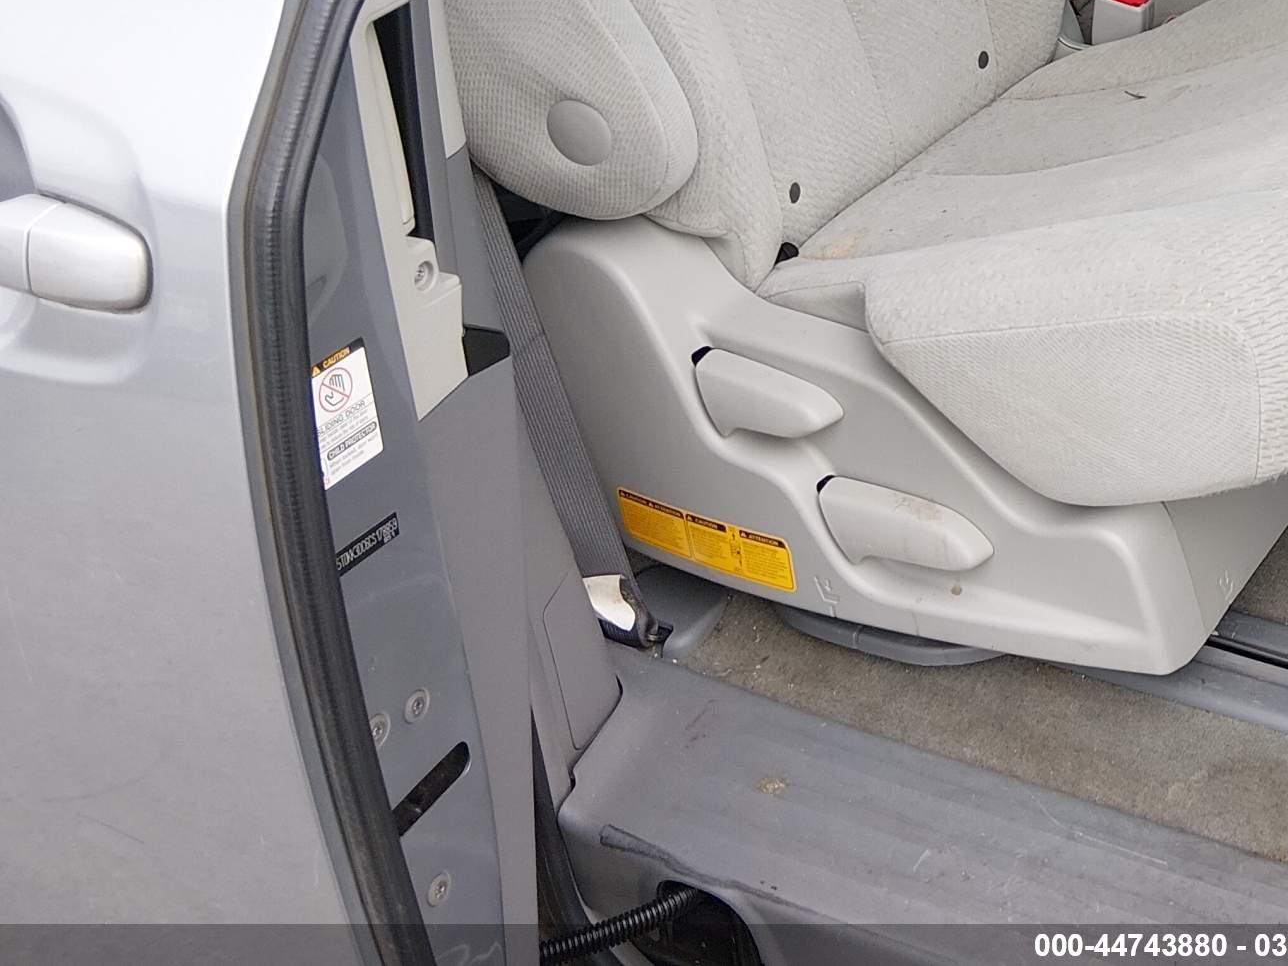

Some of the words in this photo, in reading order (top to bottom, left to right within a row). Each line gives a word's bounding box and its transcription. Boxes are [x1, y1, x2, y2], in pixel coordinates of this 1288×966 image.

[322, 346, 351, 369] CAUTION
[345, 399, 366, 418] DOOR
[329, 442, 345, 459] CHILD
[344, 422, 377, 447] PROTECTOR
